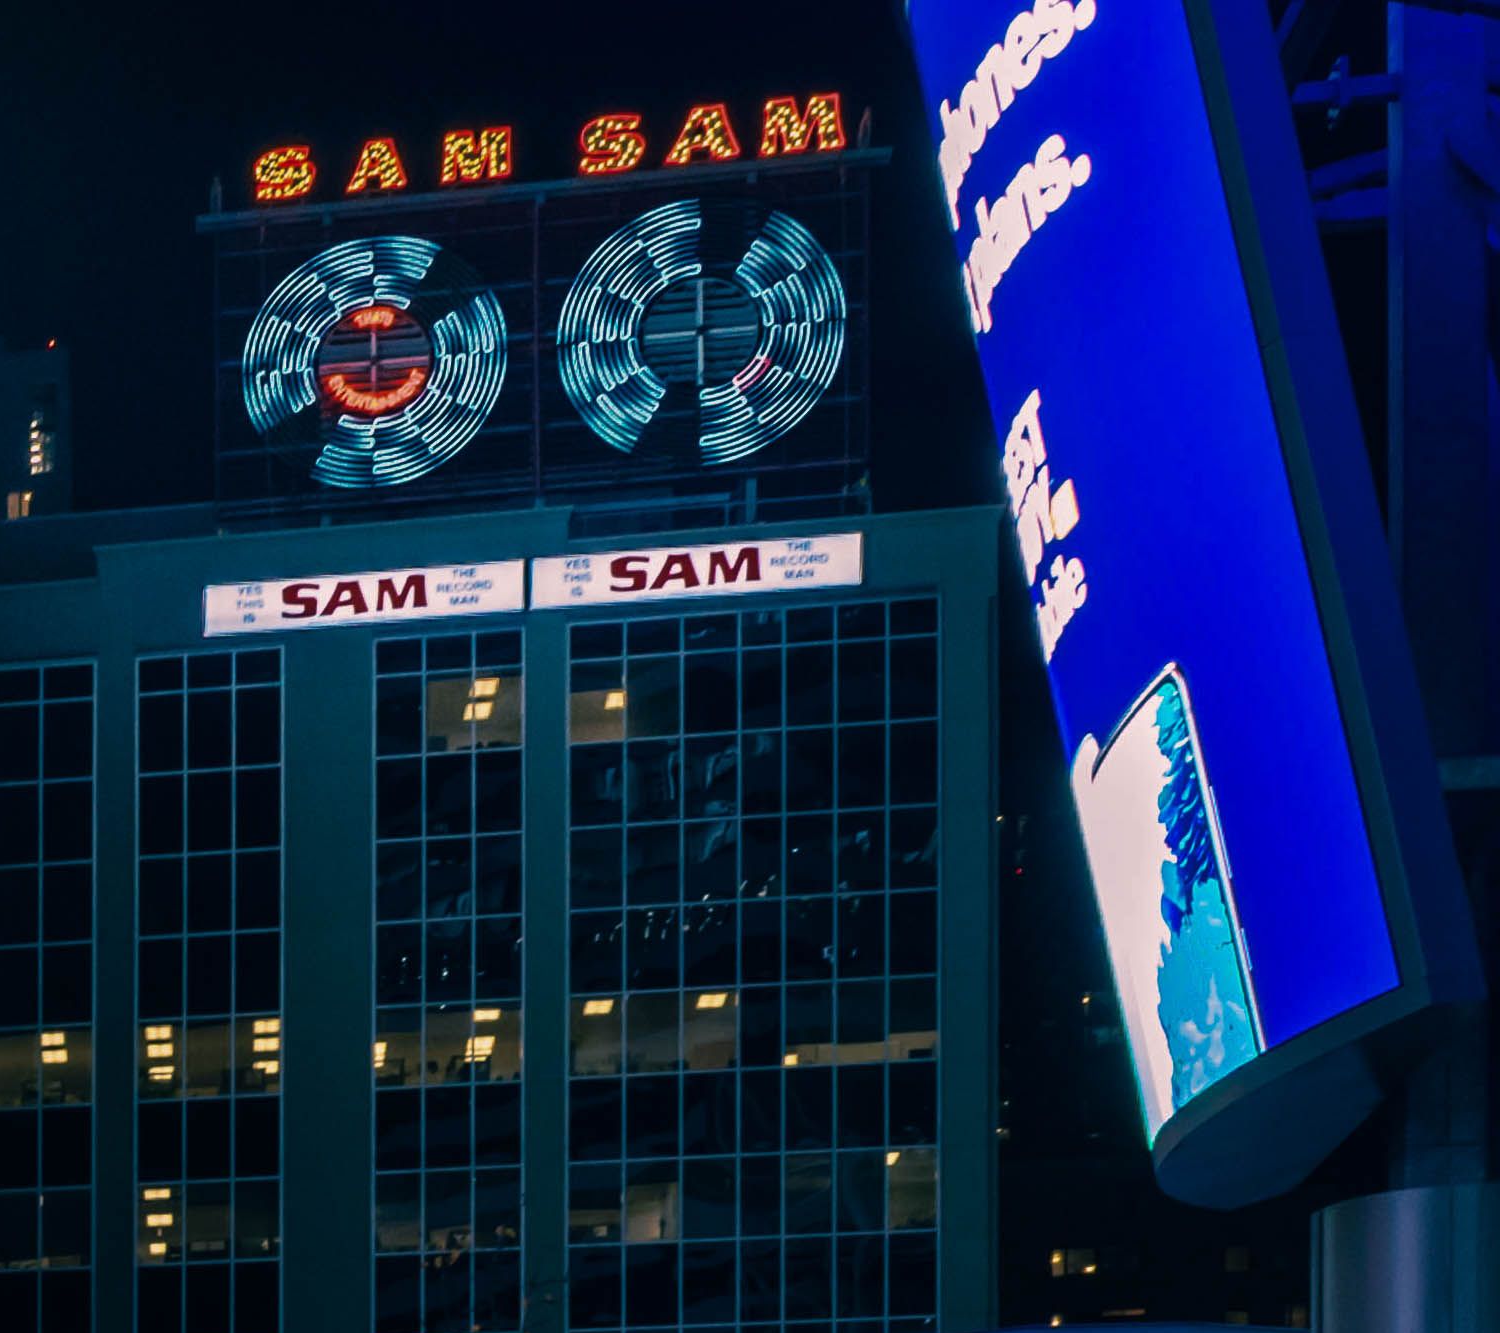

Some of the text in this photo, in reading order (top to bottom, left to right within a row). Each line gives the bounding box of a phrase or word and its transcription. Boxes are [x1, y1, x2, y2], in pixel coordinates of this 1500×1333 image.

[253, 93, 847, 200] SAM SAM
[785, 541, 813, 552] THE
[769, 552, 830, 567] RECORD
[451, 568, 478, 579] THE
[610, 547, 762, 592] SAM
[436, 579, 493, 593] RECORD
[280, 574, 428, 619] SAM
